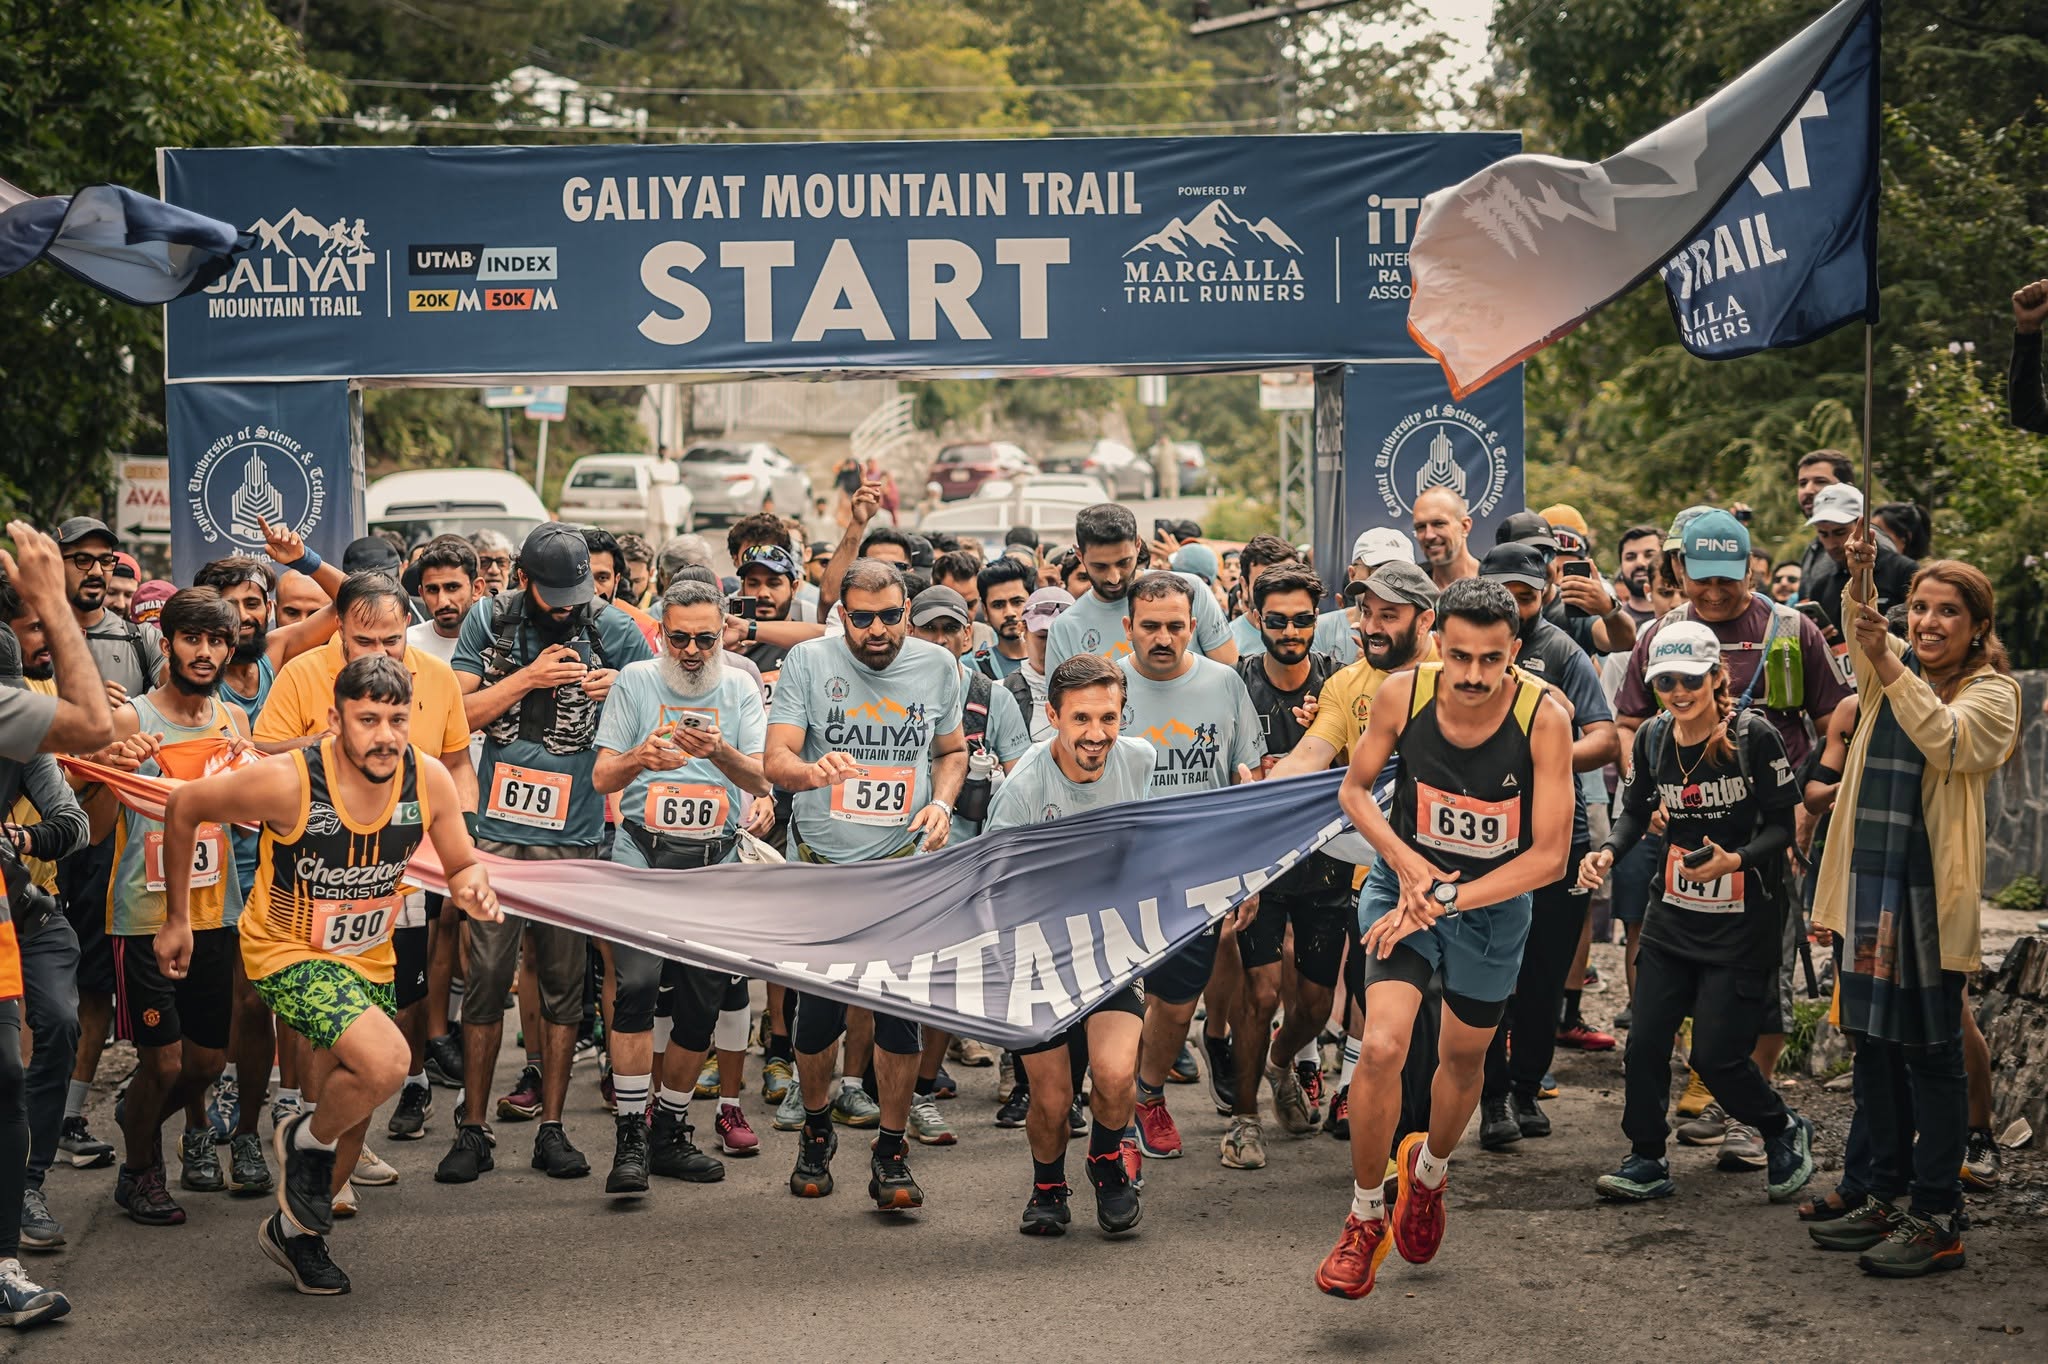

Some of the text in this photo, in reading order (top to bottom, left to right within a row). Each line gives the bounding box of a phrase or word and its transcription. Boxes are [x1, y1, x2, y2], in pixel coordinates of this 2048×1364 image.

[563, 171, 1142, 222] GALIYAT MOUNTAIN TRAIL
[1178, 186, 1247, 196] POWERED BY
[1367, 194, 1424, 244] iT
[417, 251, 551, 272] UTMB INDEX
[1668, 212, 1787, 300] TRAIL
[1124, 259, 1304, 283] MARGALLA
[637, 238, 1070, 345] START
[1124, 284, 1305, 303] TRAIL RUNNERS
[209, 296, 362, 318] MOUNTAIN TRAIL
[237, 426, 250, 441] of
[255, 425, 302, 452] Science
[188, 434, 233, 492] University
[301, 451, 314, 466] &
[1375, 404, 1509, 518] Capital University of Science & Technology
[126, 487, 170, 506] AVA
[188, 497, 218, 543] Capital
[1696, 538, 1739, 552] PING
[1655, 642, 1693, 657] HOKA
[824, 723, 929, 747] GALIYAT
[893, 750, 918, 761] TRAIL
[1151, 771, 1209, 787] TAIN TRAIL
[1700, 776, 1747, 808] CLUB
[505, 781, 551, 813] 679
[857, 781, 905, 810] 529
[663, 798, 713, 826] 636
[1438, 807, 1499, 844] 639
[313, 880, 396, 900] PAKISTAN
[330, 909, 384, 944] 590
[780, 896, 1169, 1027] NTAIN
